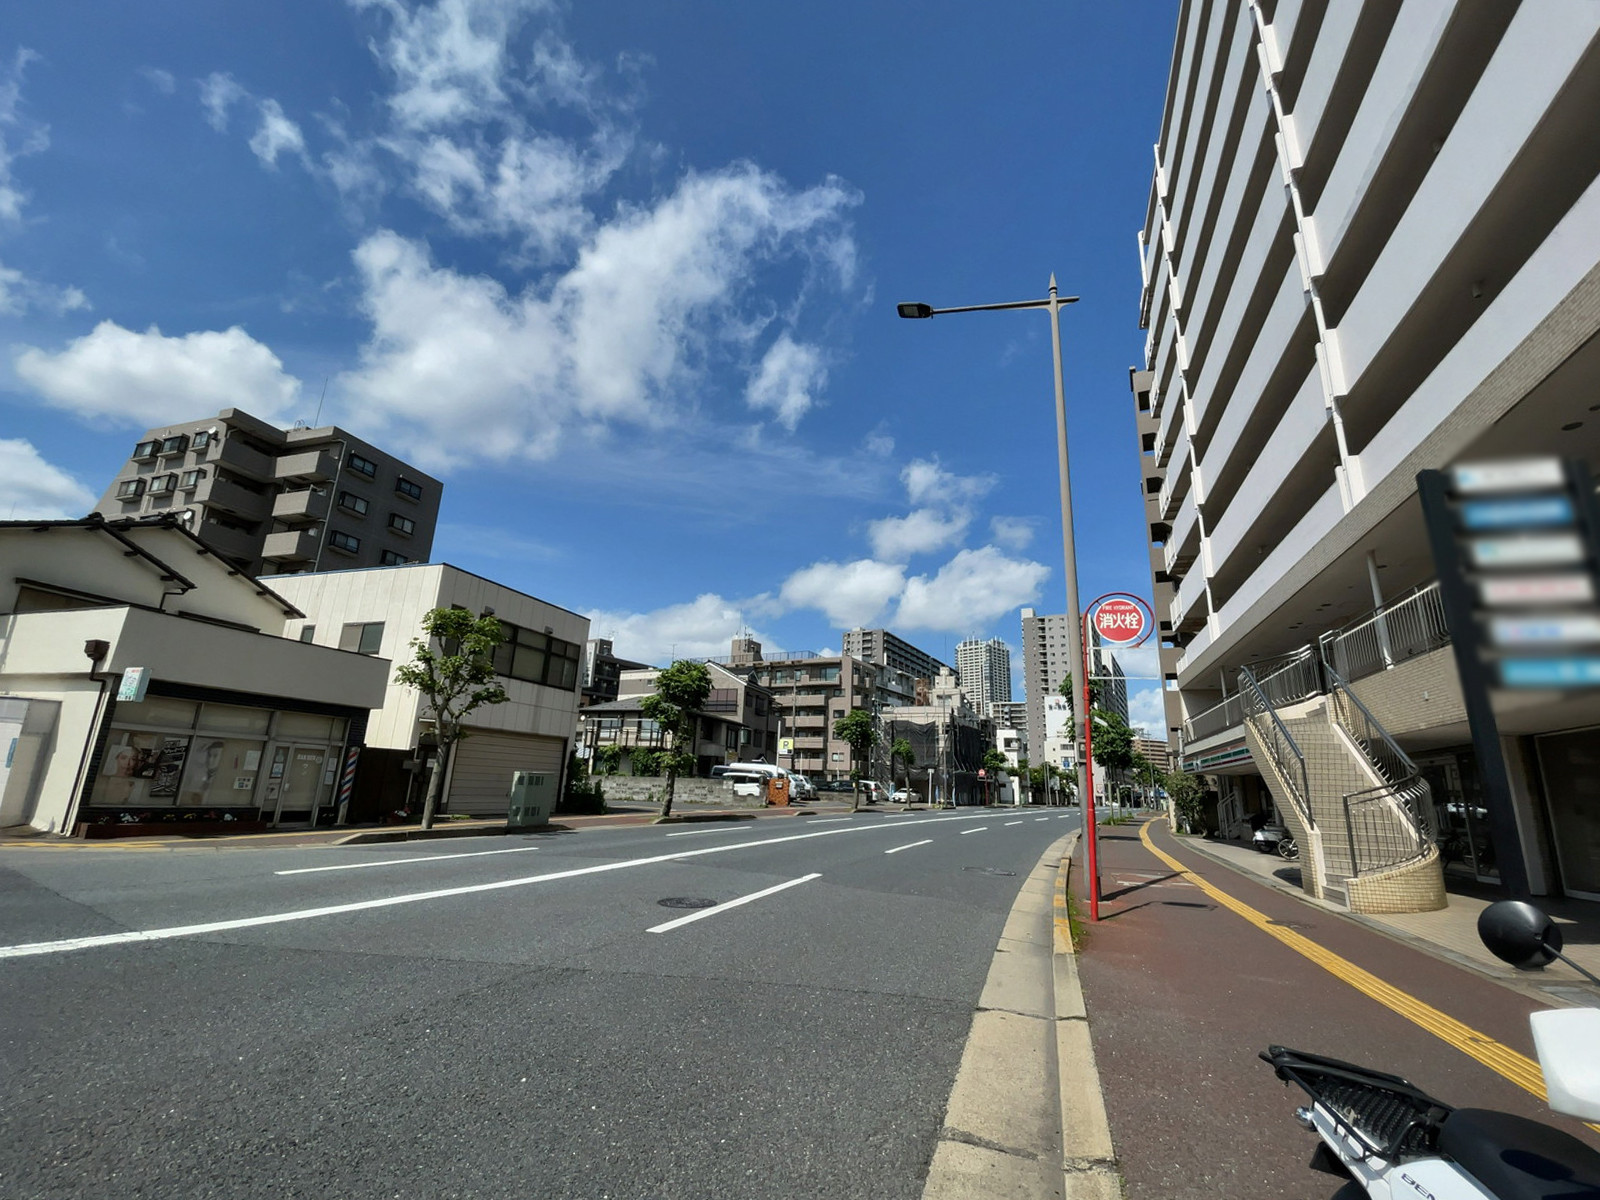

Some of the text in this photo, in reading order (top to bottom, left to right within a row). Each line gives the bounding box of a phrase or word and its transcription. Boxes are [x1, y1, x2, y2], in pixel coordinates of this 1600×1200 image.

[1099, 612, 1140, 629] 消火栓
[783, 740, 789, 749] P
